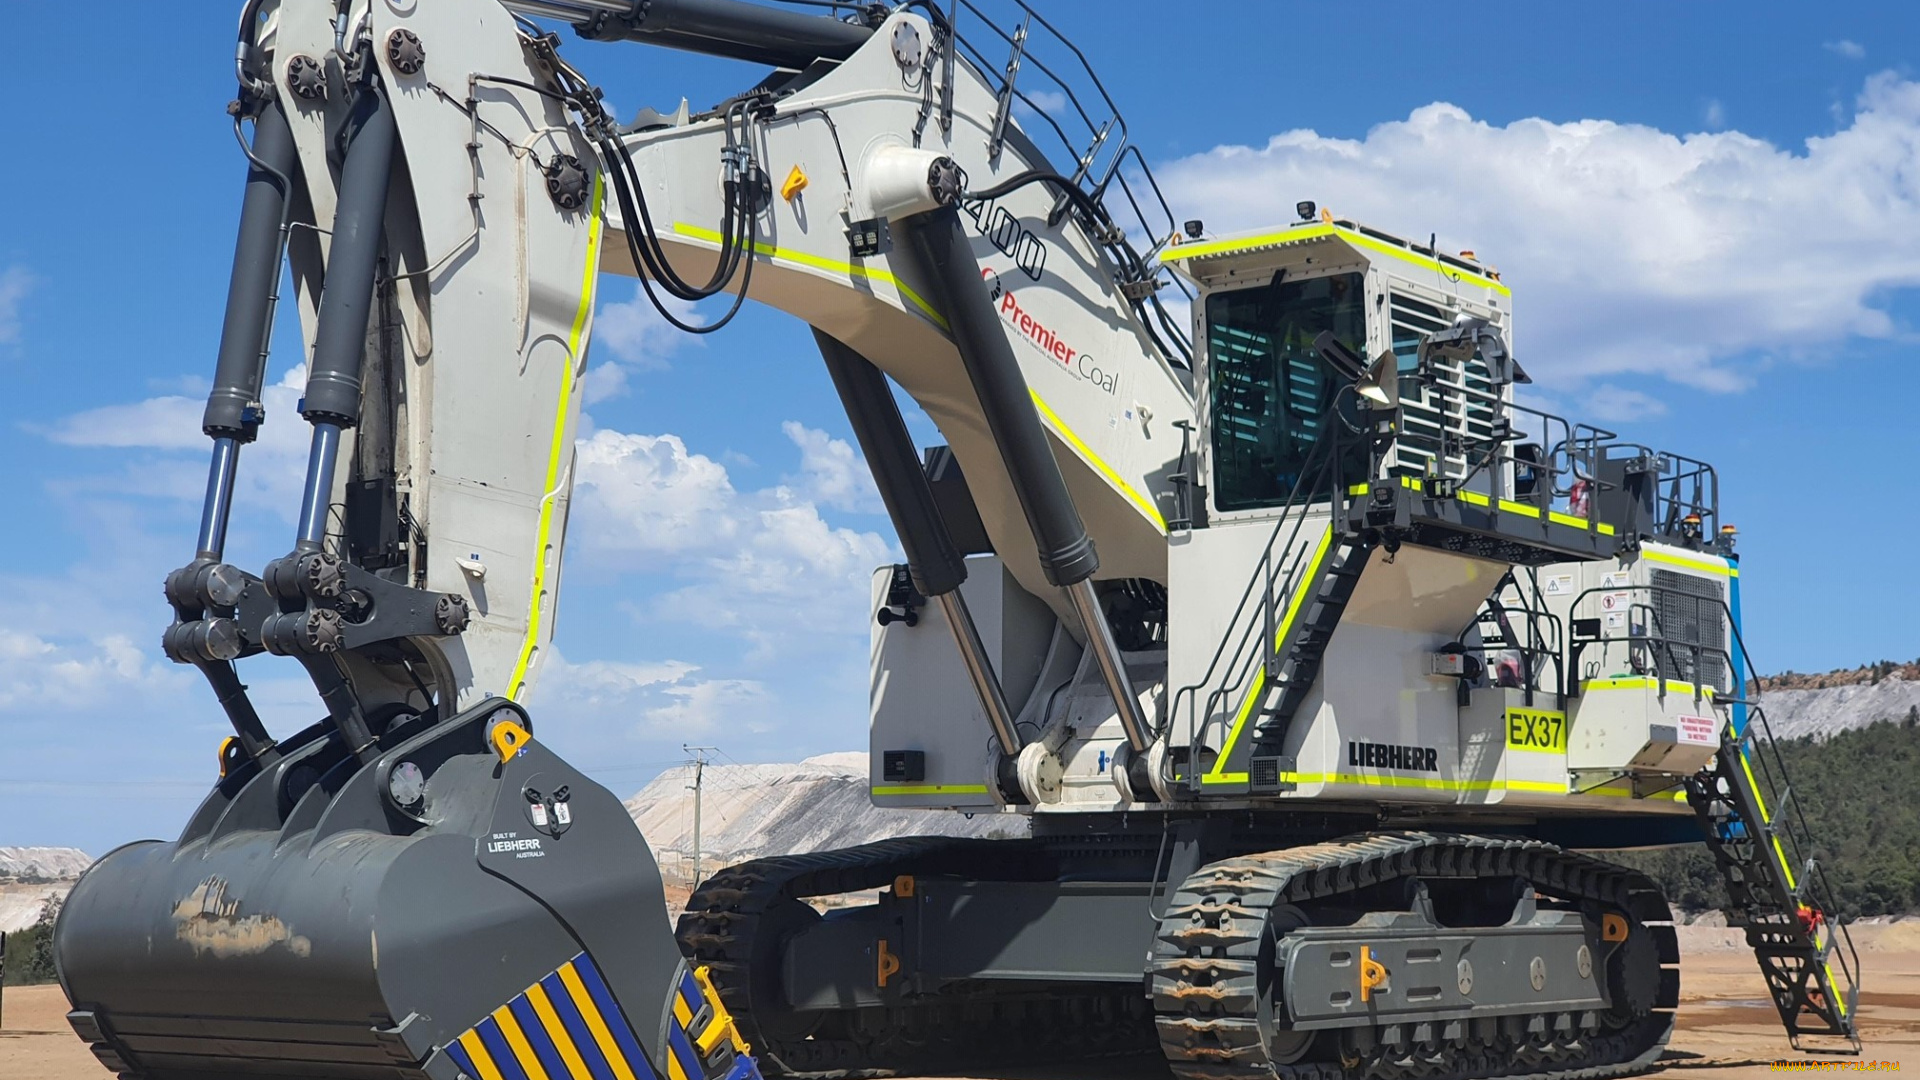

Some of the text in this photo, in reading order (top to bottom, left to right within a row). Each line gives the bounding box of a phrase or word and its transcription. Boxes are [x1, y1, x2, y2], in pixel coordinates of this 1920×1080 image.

[1001, 290, 1119, 396] Premier Coal
[1509, 713, 1562, 748] EX37
[1349, 741, 1438, 772] LIEBHERR
[487, 839, 541, 853] LIEBHERR
[516, 851, 545, 859] AUSTRALIA
